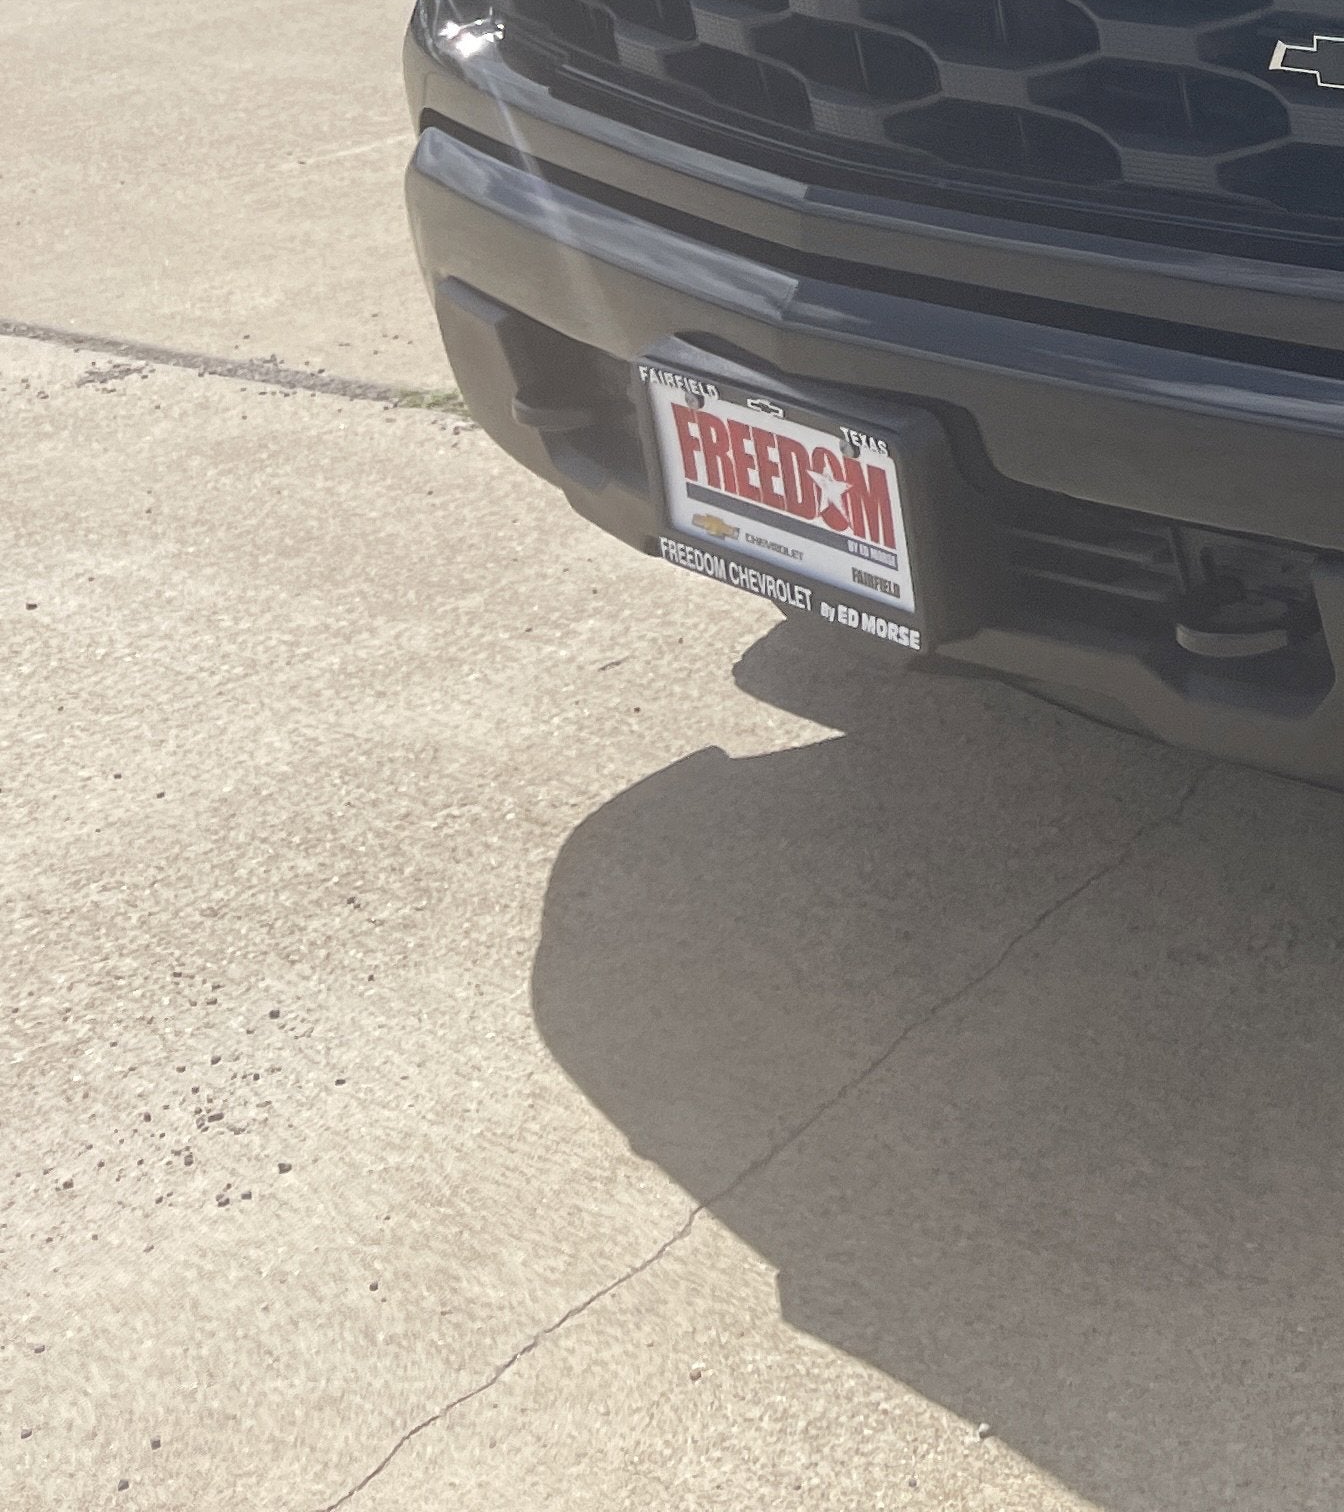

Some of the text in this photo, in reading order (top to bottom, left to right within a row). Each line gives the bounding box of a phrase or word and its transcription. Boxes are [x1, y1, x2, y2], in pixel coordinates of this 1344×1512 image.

[638, 365, 719, 400] FAIRFIELD
[840, 427, 889, 457] TEXAS
[670, 402, 897, 549] FREEDOM
[745, 532, 804, 561] CHEVROLET
[659, 536, 727, 583] FREEDOM
[728, 563, 813, 612] CHEVROLET
[837, 604, 860, 629] ED
[861, 613, 921, 650] MORSE
